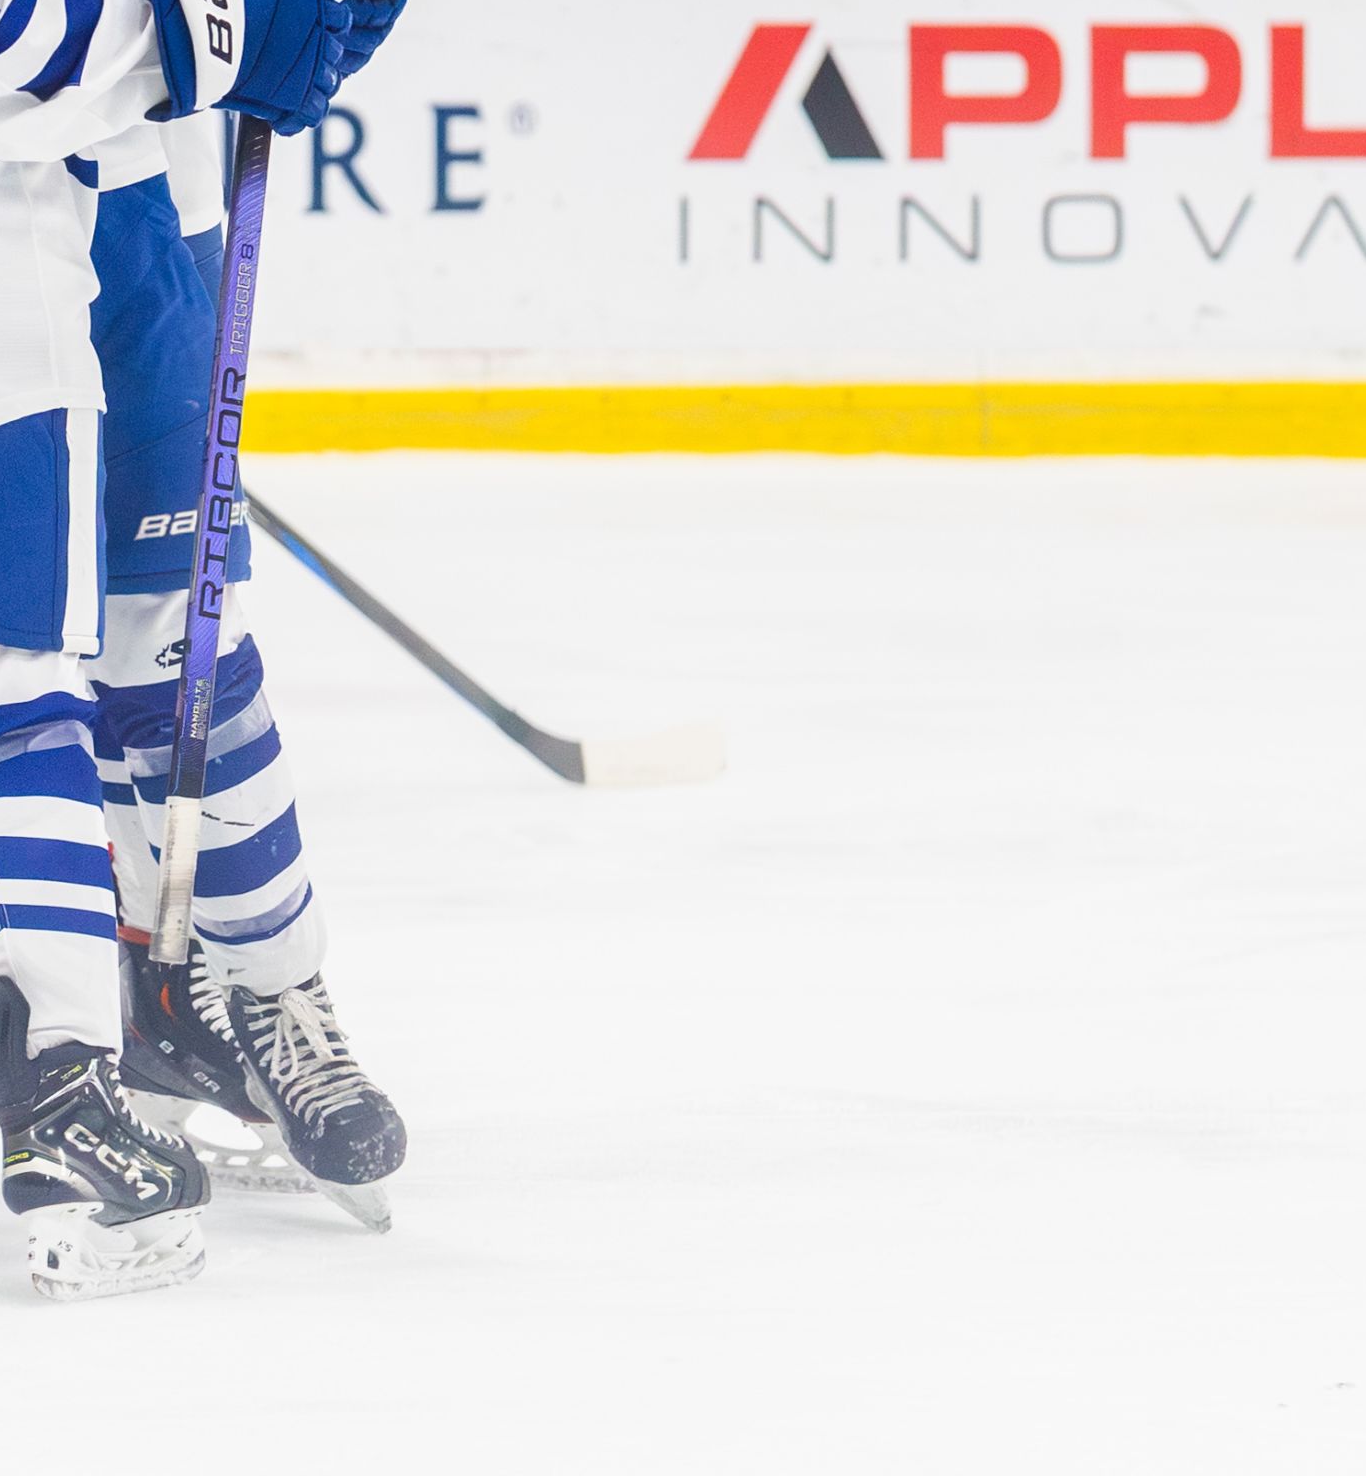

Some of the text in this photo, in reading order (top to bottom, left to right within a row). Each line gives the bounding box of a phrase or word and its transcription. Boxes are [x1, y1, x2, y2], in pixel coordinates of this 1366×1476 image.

[198, 366, 247, 621] RIBCOR
[229, 261, 253, 356] TRIGGER
[134, 499, 251, 541] BAER
[158, 1039, 222, 1094] BER
[63, 1122, 161, 1201] CCM
